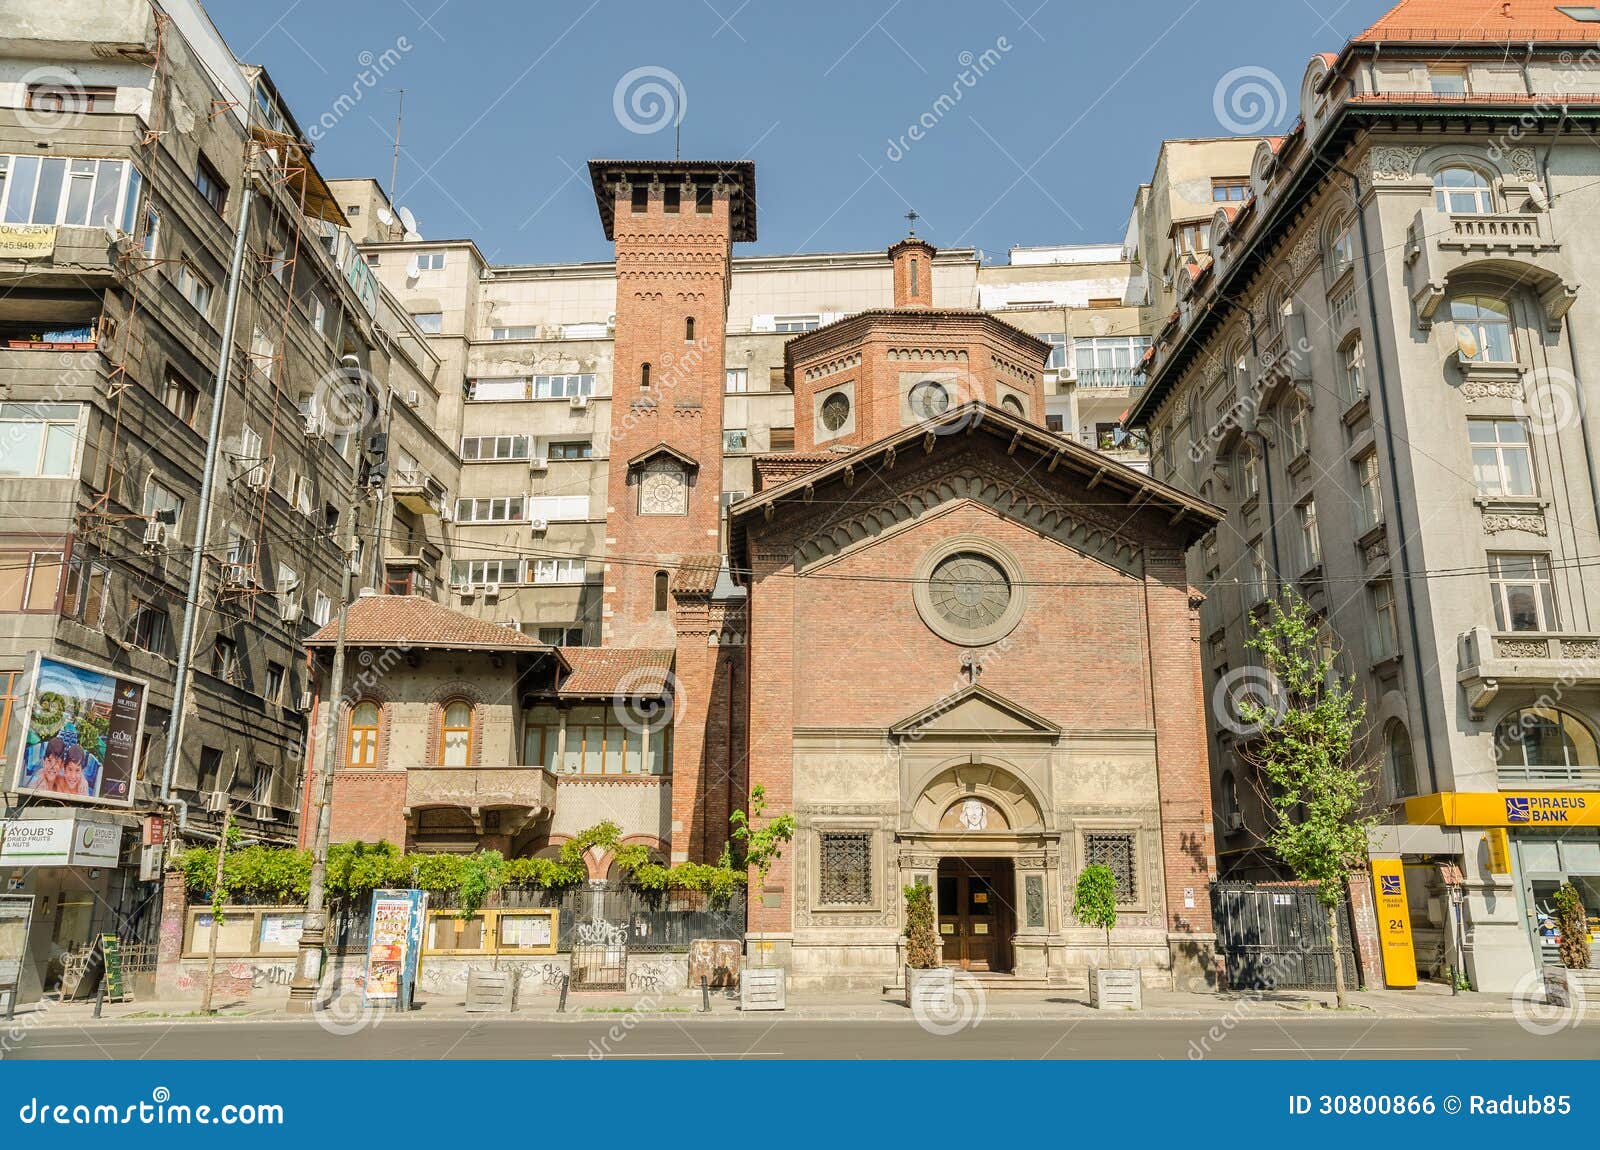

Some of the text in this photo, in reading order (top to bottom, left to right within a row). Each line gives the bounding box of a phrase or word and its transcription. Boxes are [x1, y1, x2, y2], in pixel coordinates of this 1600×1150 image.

[1530, 797, 1586, 809] PIRAEUS
[1532, 810, 1568, 821] BANK
[8, 827, 54, 836] AYOUB'S
[1389, 919, 1403, 929] 24
